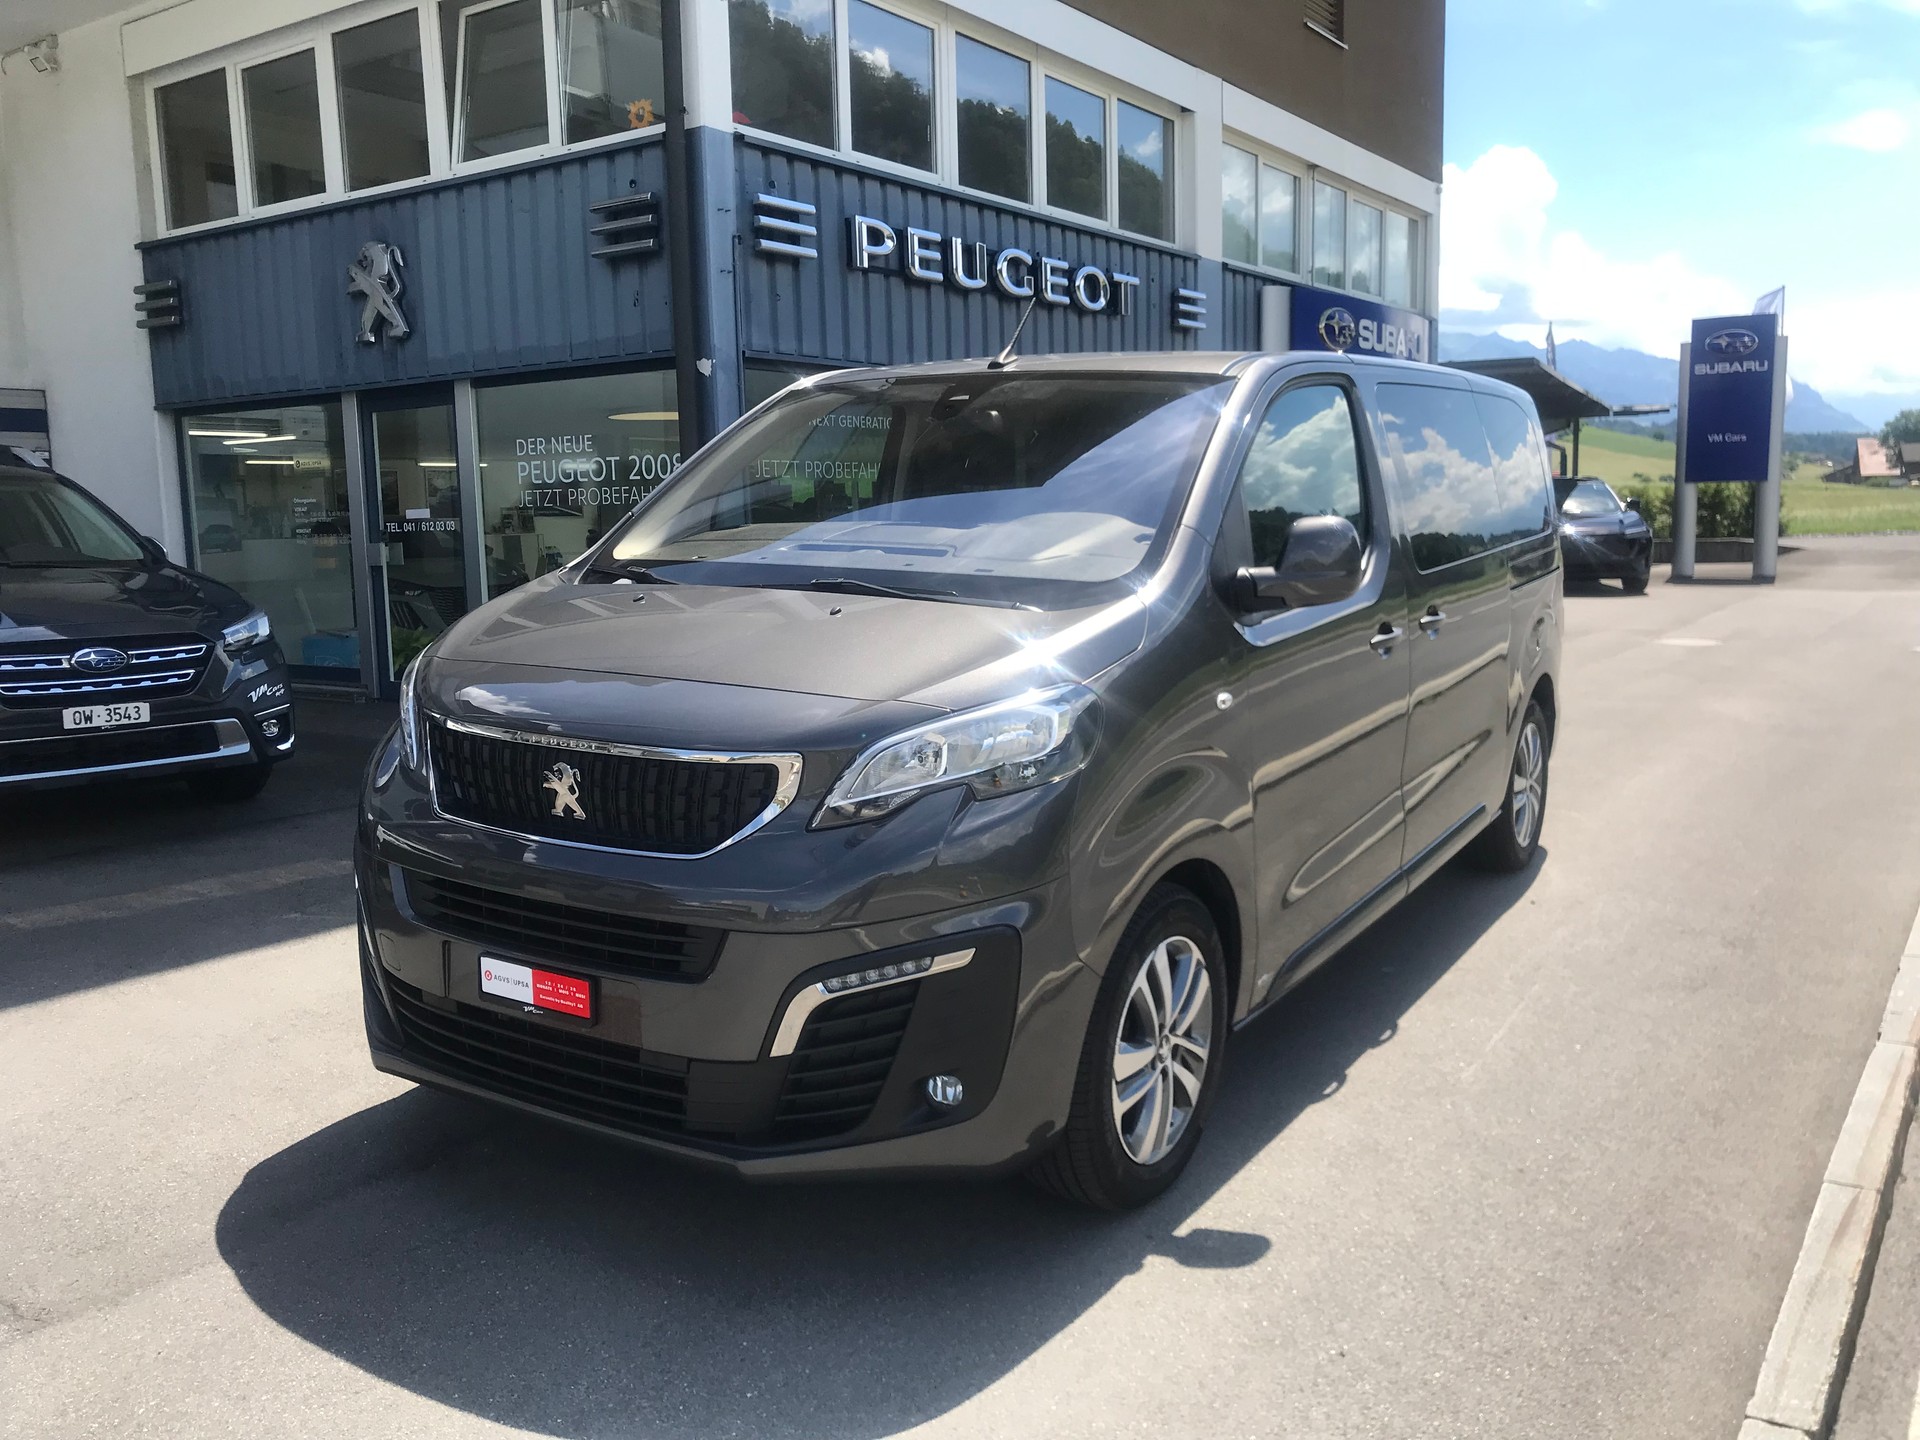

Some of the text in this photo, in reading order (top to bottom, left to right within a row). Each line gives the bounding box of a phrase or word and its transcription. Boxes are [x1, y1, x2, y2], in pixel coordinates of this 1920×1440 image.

[852, 214, 1140, 316] PEUGEOT
[1694, 360, 1769, 375] SUBARU
[516, 434, 593, 456] DER NEUE
[1707, 432, 1747, 443] VM Cars
[517, 456, 620, 485] PEUGEOT
[756, 459, 881, 480] JETZT PROBEFAH
[518, 485, 658, 508] JETZT PROBEFAH
[386, 522, 402, 533] TEL.
[403, 522, 416, 532] 041
[421, 521, 435, 531] 612
[435, 521, 445, 531] 03
[446, 520, 455, 531] 03
[73, 705, 142, 726] OW 3543
[531, 736, 596, 750] PEUGEOT
[493, 974, 530, 989] AGVS UPSA
